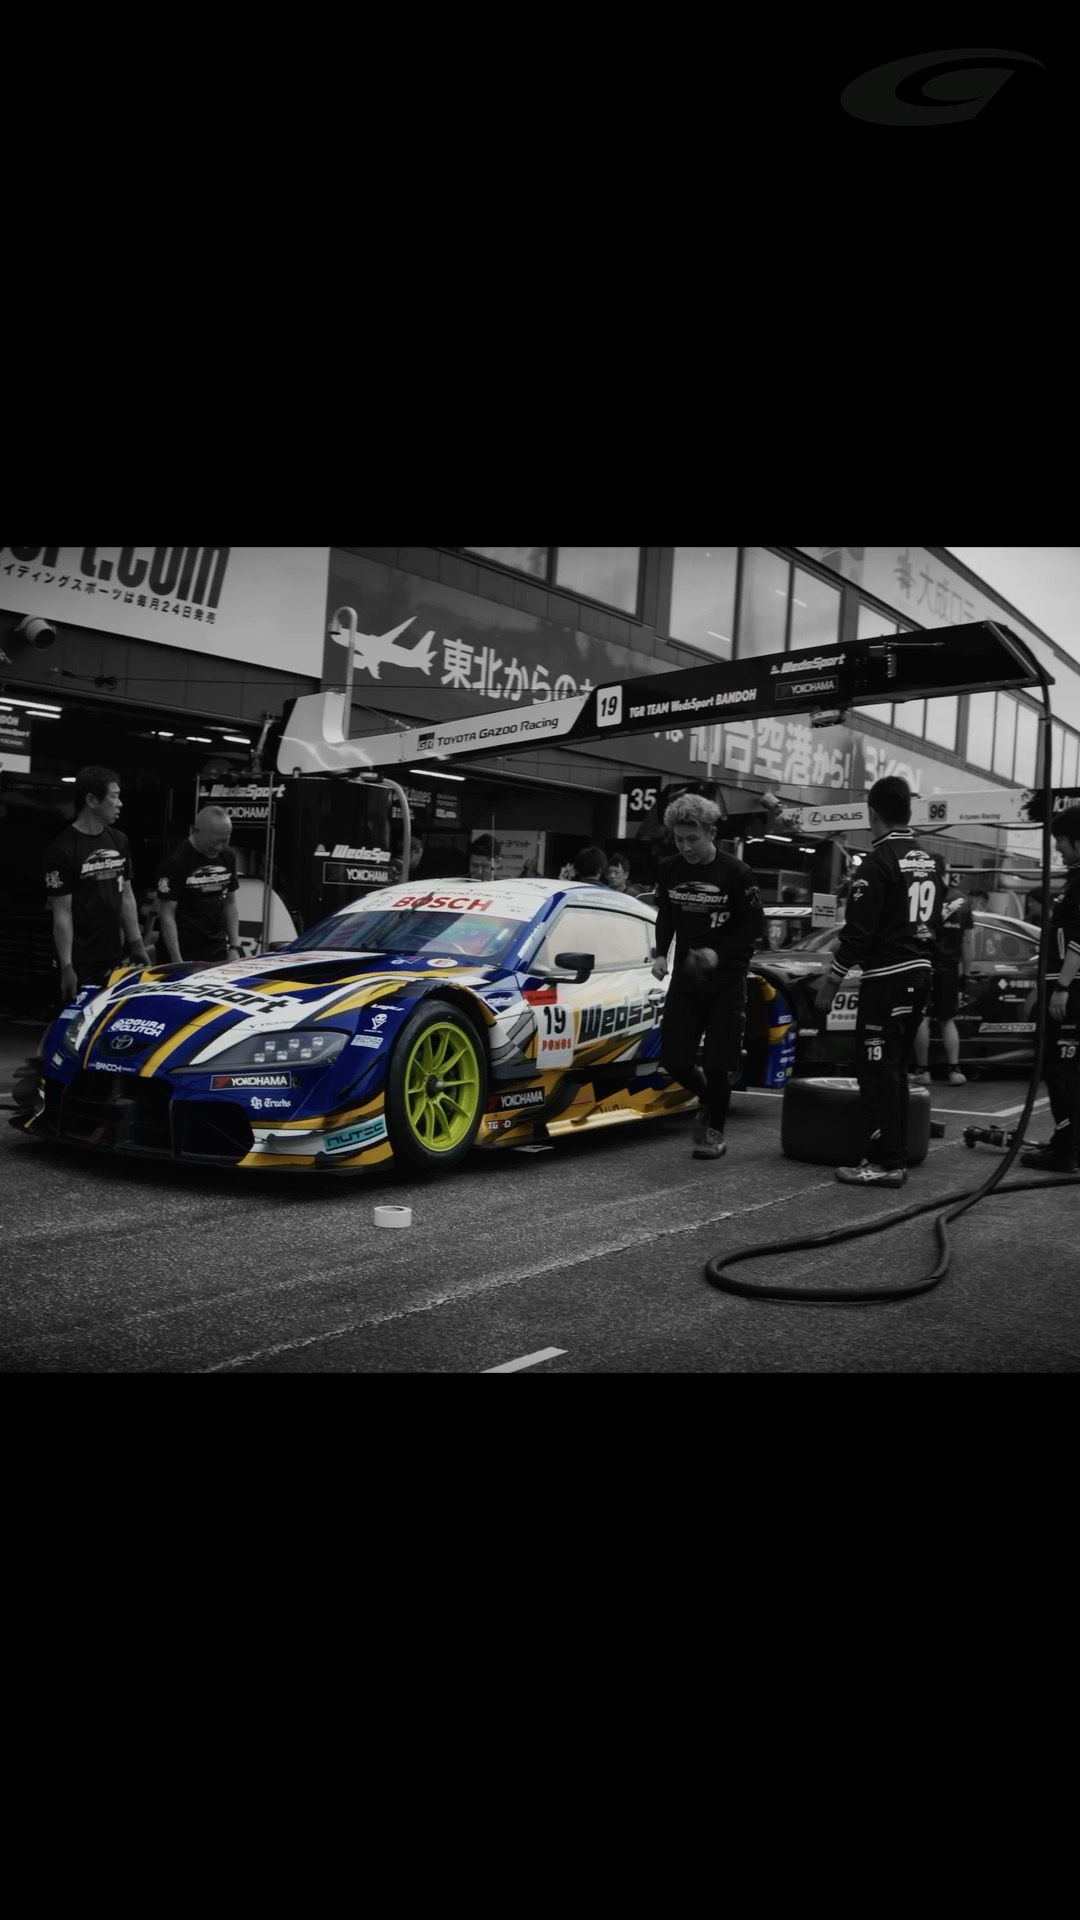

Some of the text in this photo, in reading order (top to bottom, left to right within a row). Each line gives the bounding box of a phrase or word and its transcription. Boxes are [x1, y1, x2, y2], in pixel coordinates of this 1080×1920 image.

[780, 653, 847, 673] WedsSport
[791, 679, 835, 695] YOKOHAMA
[600, 695, 619, 718] 19
[629, 688, 757, 718] TGR TEAM WedsSport BANDOH
[437, 732, 477, 747] TOYOTA
[479, 724, 518, 739] GAZOO
[520, 717, 559, 733] Racing
[210, 784, 287, 800] WedsSport
[629, 788, 658, 811] 35
[822, 811, 863, 823] LEXUS
[929, 804, 946, 819] 96
[391, 896, 494, 912] BOSCH
[667, 889, 729, 905] WedsSport
[908, 880, 936, 922] 19
[709, 911, 731, 928] 19
[834, 995, 860, 1011] 96
[125, 1018, 166, 1031] OGURA
[543, 1005, 566, 1035] 19
[119, 1025, 162, 1038] CLUTCH
[541, 1038, 573, 1052] PONOS
[1060, 1045, 1077, 1059] 19
[867, 1046, 883, 1061] 19
[230, 1075, 288, 1087] YOKOHAMA
[500, 1090, 544, 1107] YOKOHAMA
